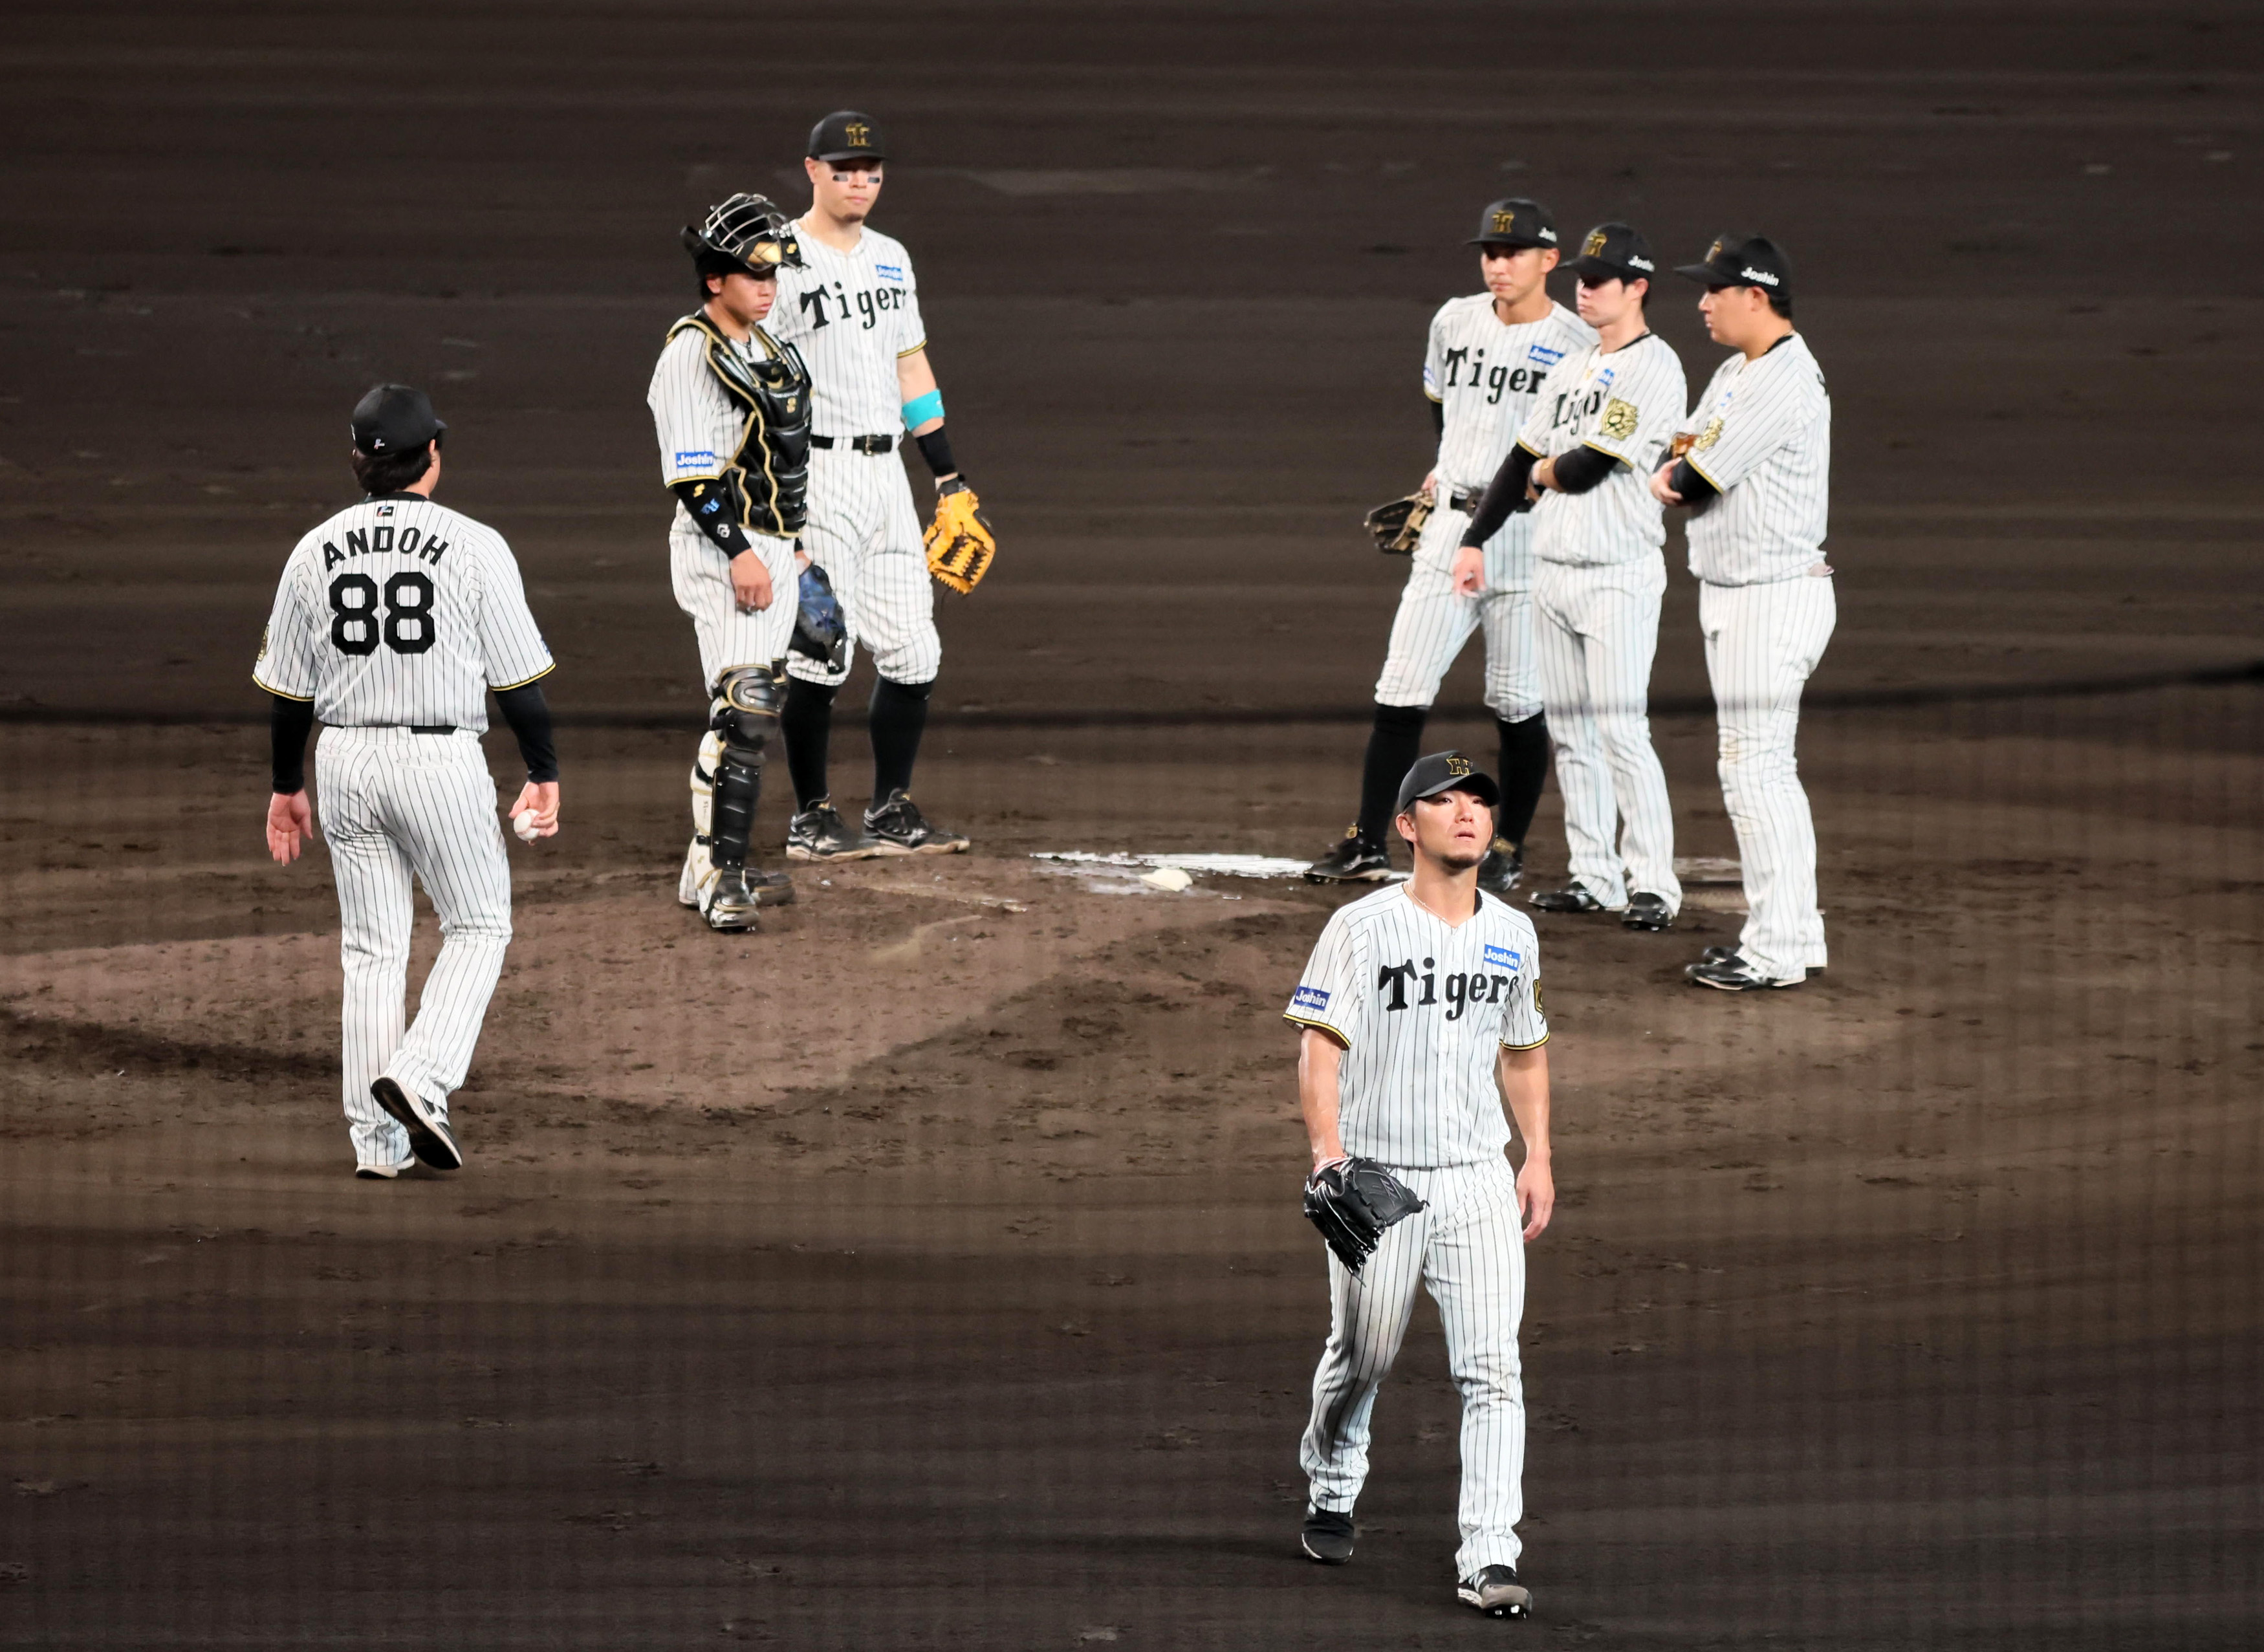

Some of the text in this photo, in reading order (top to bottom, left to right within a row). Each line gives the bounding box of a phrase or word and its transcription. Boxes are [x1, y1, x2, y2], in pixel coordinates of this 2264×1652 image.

[1741, 266, 1779, 286] Joshin
[800, 281, 906, 330] Tiger
[1445, 347, 1547, 405] Tiger
[677, 453, 713, 466] Joshin
[323, 526, 449, 572] ANDOH
[329, 571, 436, 657] 88
[1485, 948, 1519, 968] Joshin
[1296, 990, 1327, 1007] Joshin
